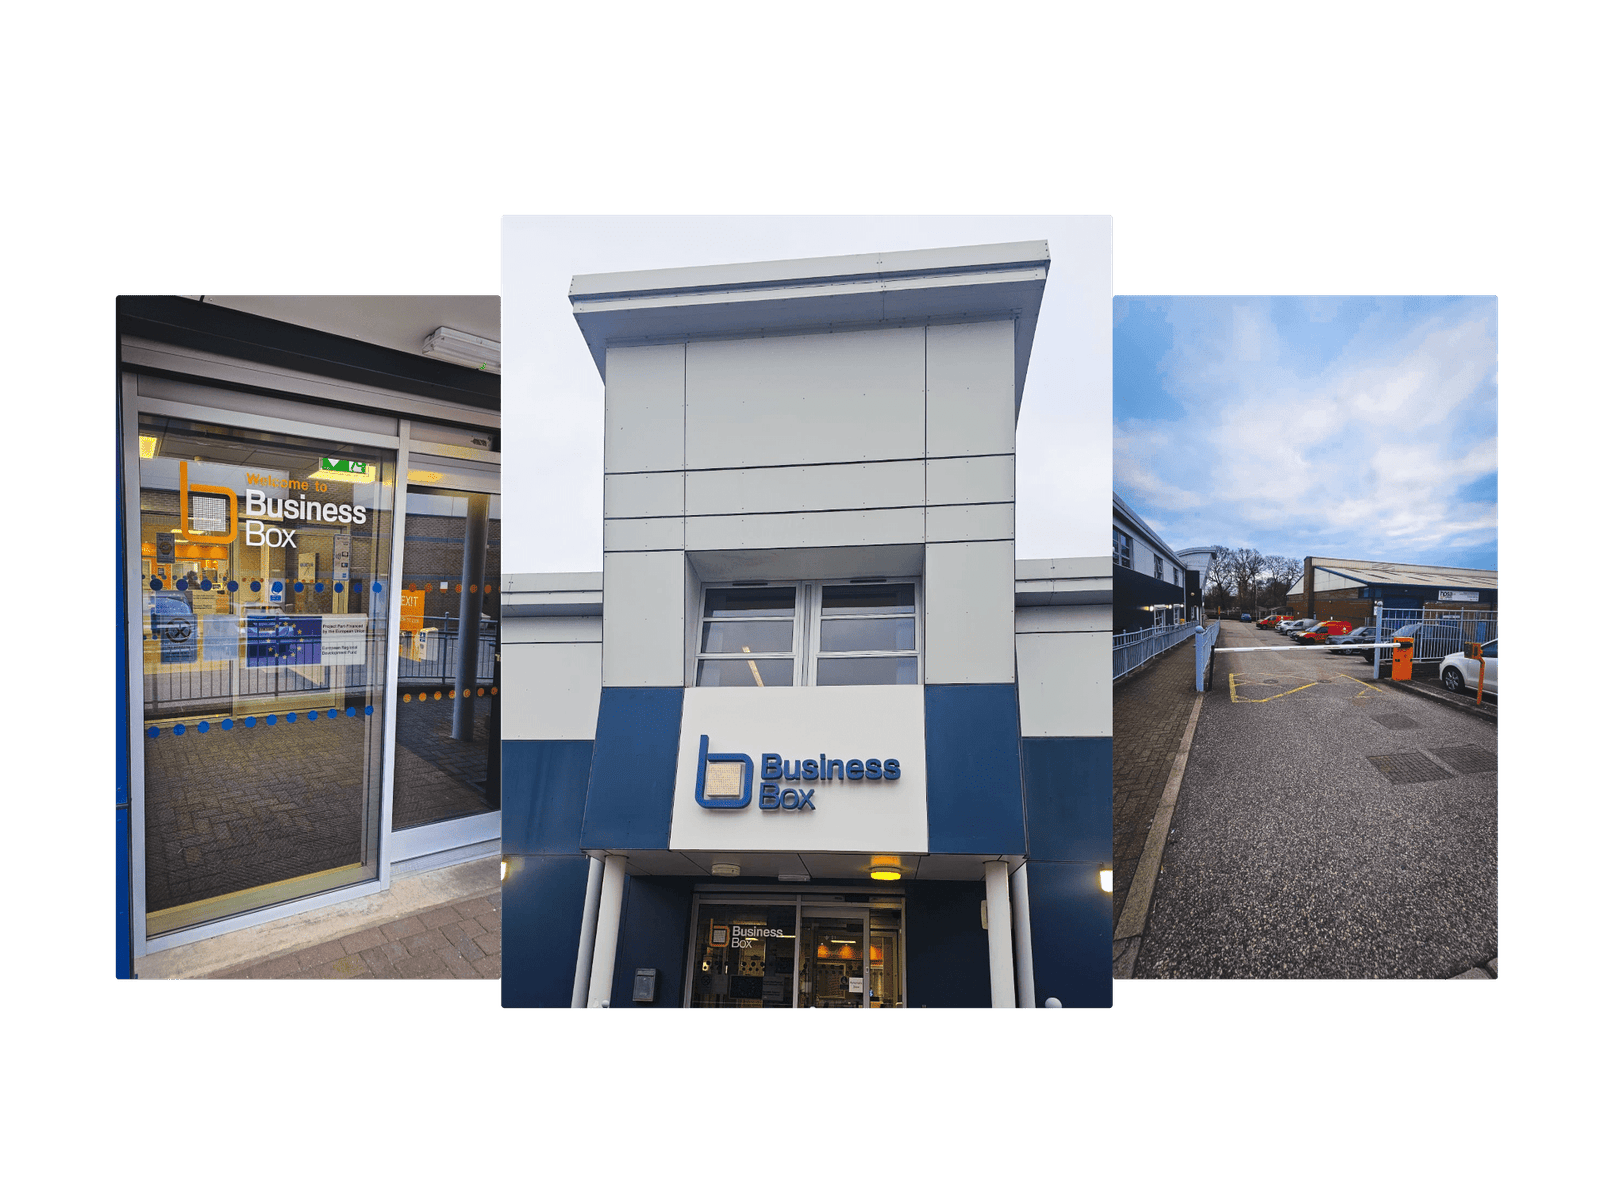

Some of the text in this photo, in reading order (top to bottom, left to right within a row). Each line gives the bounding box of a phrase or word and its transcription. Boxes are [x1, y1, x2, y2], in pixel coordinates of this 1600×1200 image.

[246, 472, 328, 492] Welcome to
[245, 488, 367, 525] Business
[245, 520, 297, 548] Box
[401, 595, 419, 607] EXIT
[760, 753, 902, 781] Business
[758, 782, 816, 811] Box
[731, 937, 753, 949] Box
[732, 925, 783, 938] Business
